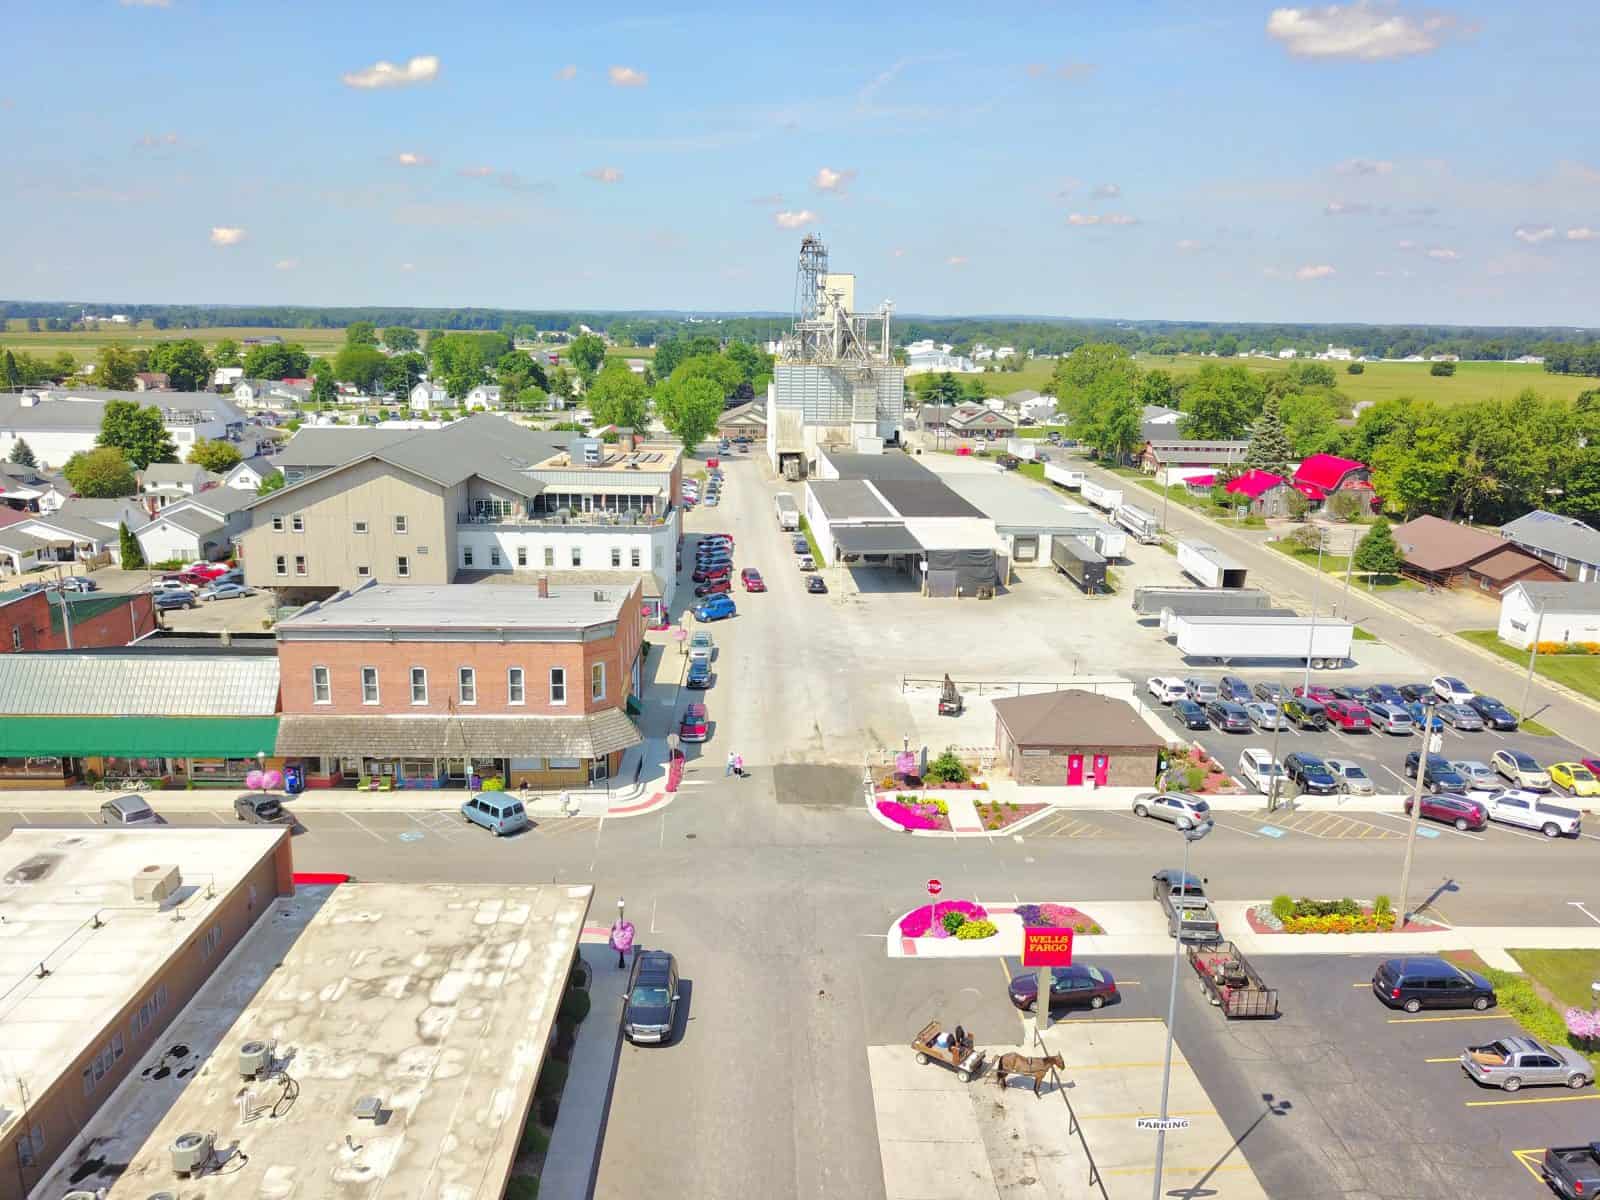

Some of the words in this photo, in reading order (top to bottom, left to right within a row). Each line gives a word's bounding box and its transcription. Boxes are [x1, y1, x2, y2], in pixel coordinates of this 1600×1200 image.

[1028, 935, 1069, 943] WELLS
[1029, 944, 1068, 952] FARGO
[1137, 1120, 1189, 1129] PARKING
